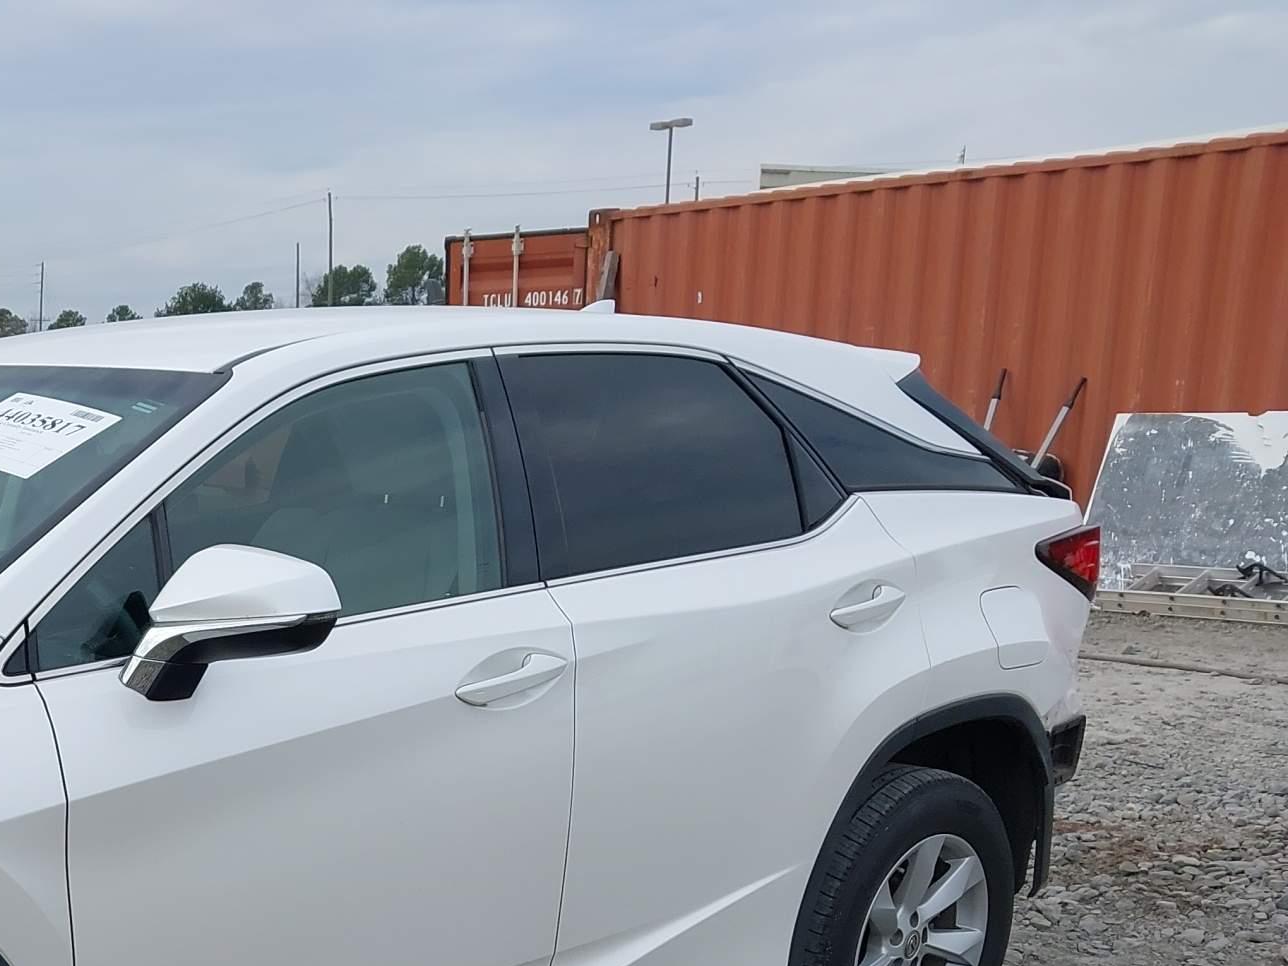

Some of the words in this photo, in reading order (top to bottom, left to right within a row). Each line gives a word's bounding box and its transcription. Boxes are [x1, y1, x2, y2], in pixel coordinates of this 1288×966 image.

[483, 293, 511, 308] TCLU
[524, 290, 569, 306] 400146
[573, 288, 583, 305] 7
